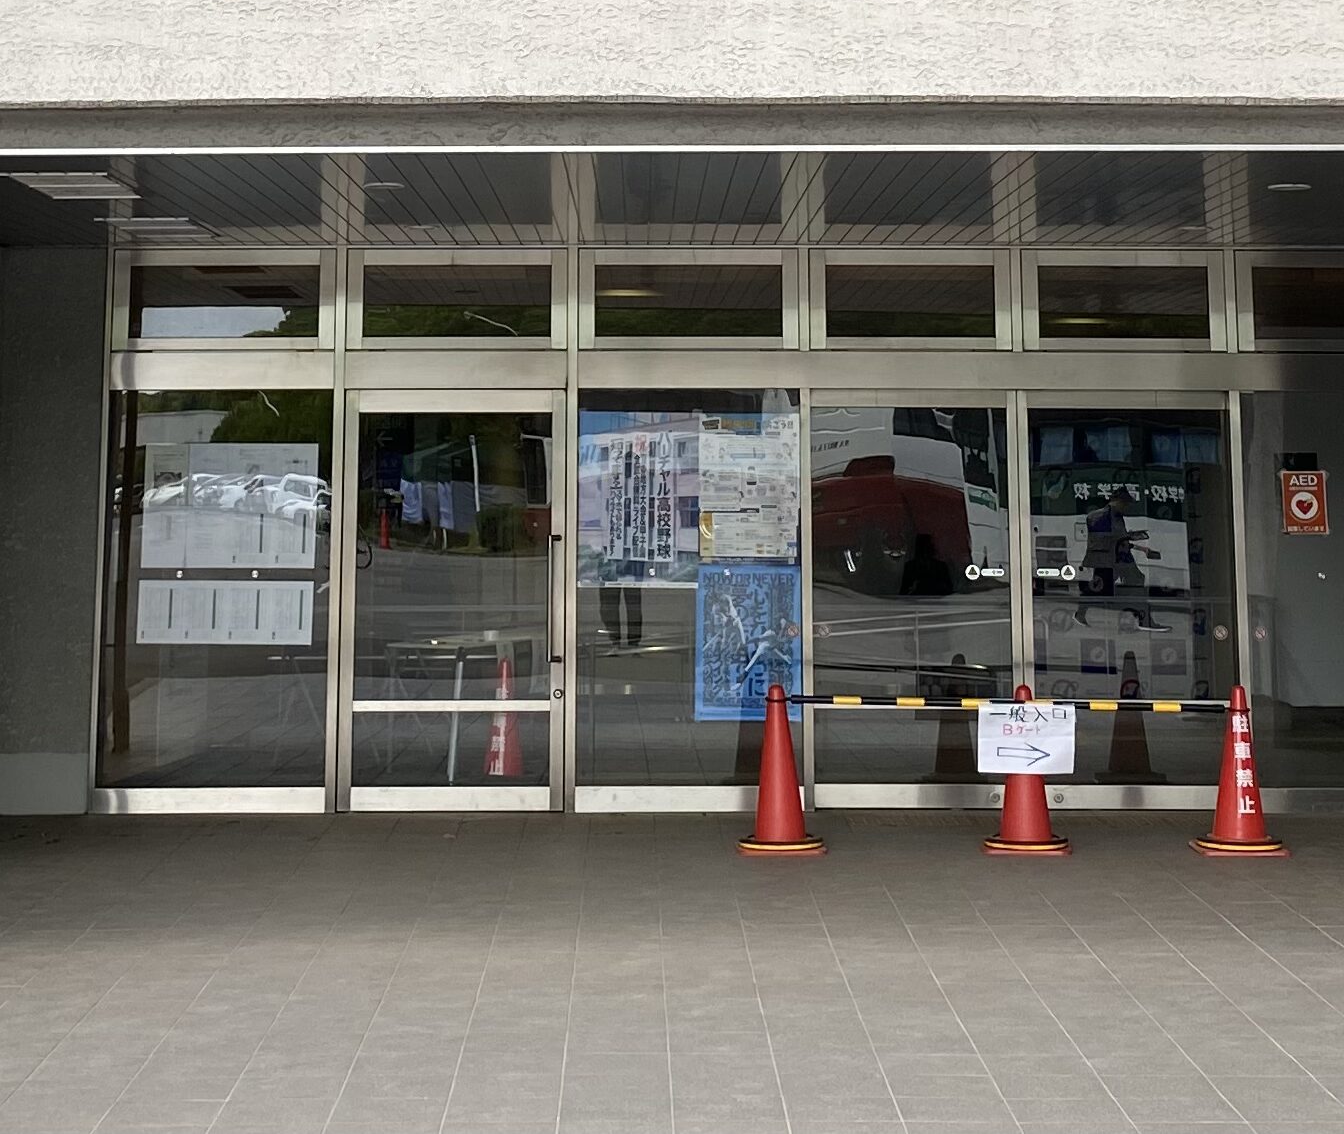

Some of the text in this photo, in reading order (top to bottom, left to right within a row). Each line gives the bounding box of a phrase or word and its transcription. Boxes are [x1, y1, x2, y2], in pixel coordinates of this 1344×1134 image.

[1289, 474, 1318, 486] AED
[752, 573, 795, 586] NEVER
[989, 706, 1067, 723] 一般入口
[1232, 713, 1256, 815] 駐車禁止
